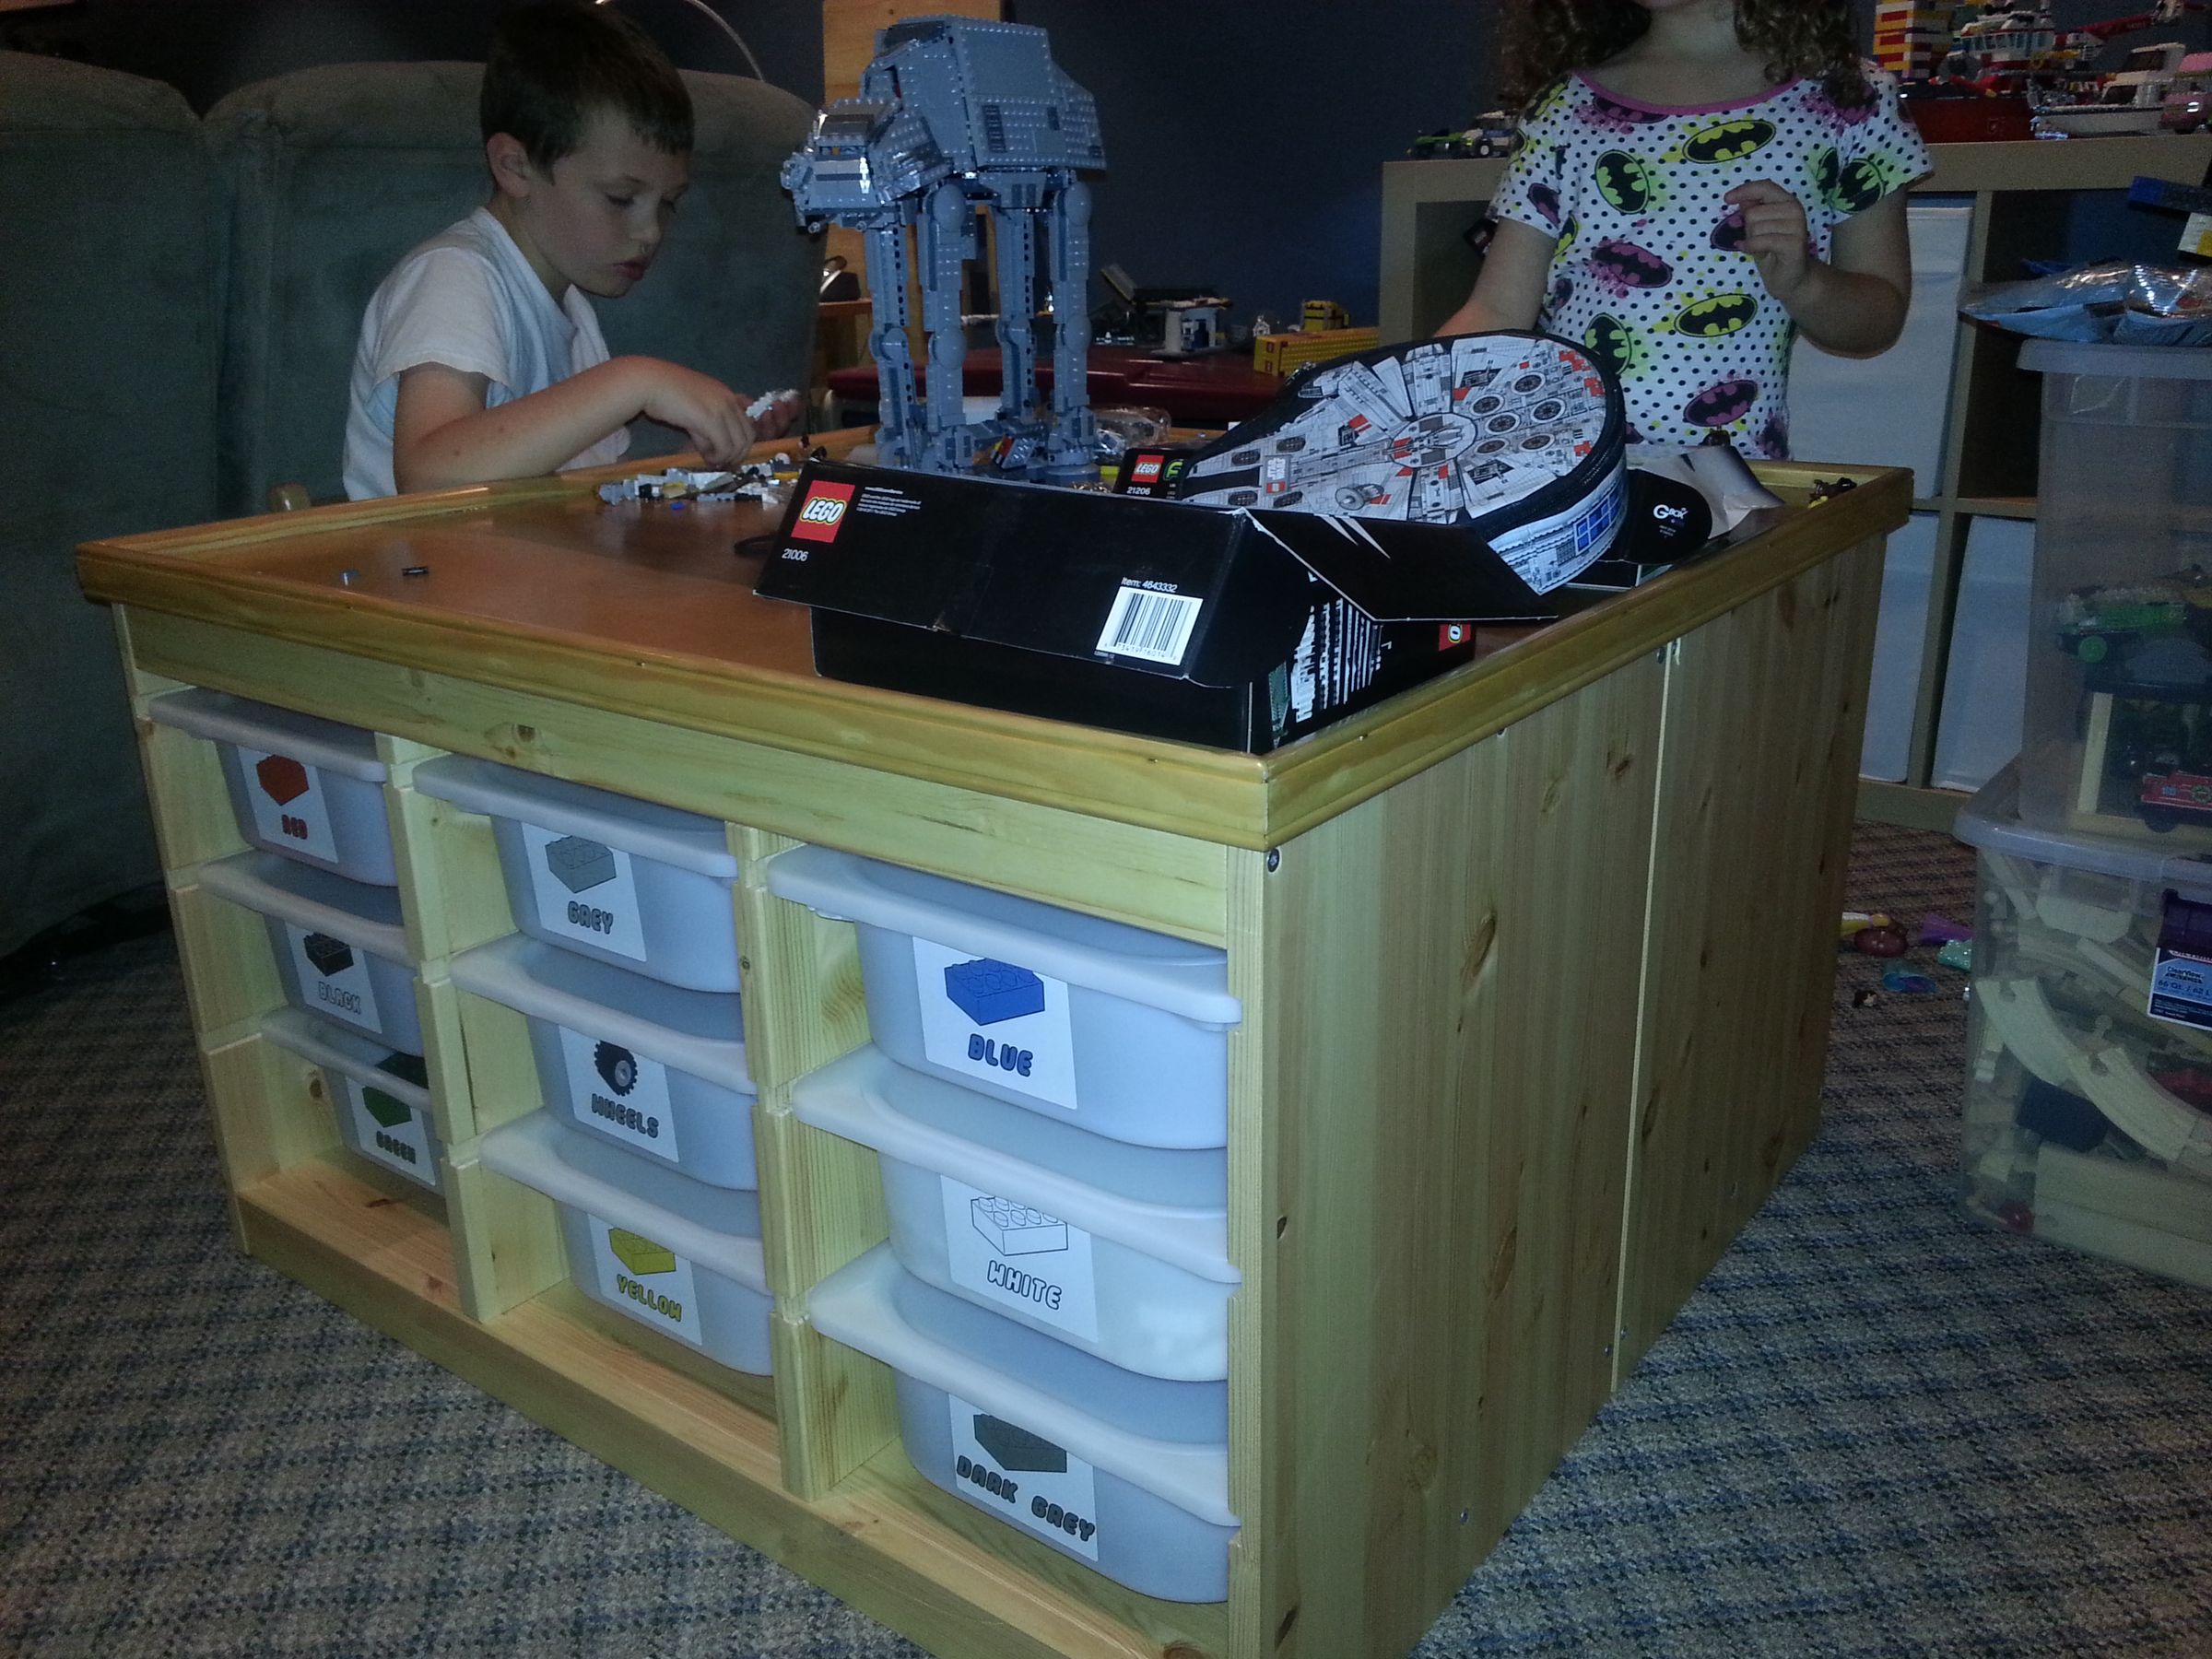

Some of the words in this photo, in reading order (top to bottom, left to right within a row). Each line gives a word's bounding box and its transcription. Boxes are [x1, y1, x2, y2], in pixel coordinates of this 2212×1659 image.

[1135, 463, 1160, 475] LEGO
[1126, 486, 1151, 495] 21206
[801, 498, 846, 524] LEGO
[782, 548, 808, 561] 21006
[1121, 576, 1141, 588] Item:
[281, 814, 308, 840] RED
[568, 900, 614, 935] GREY
[318, 981, 361, 1015] BLACK
[968, 1033, 1033, 1077] BLUE
[591, 1092, 659, 1139] WHEELS
[375, 1130, 417, 1165] GREEN
[617, 1274, 682, 1322] YELLOW
[987, 1260, 1062, 1311] WHITE
[957, 1454, 1018, 1504] DARK
[1031, 1495, 1096, 1542] GREY
